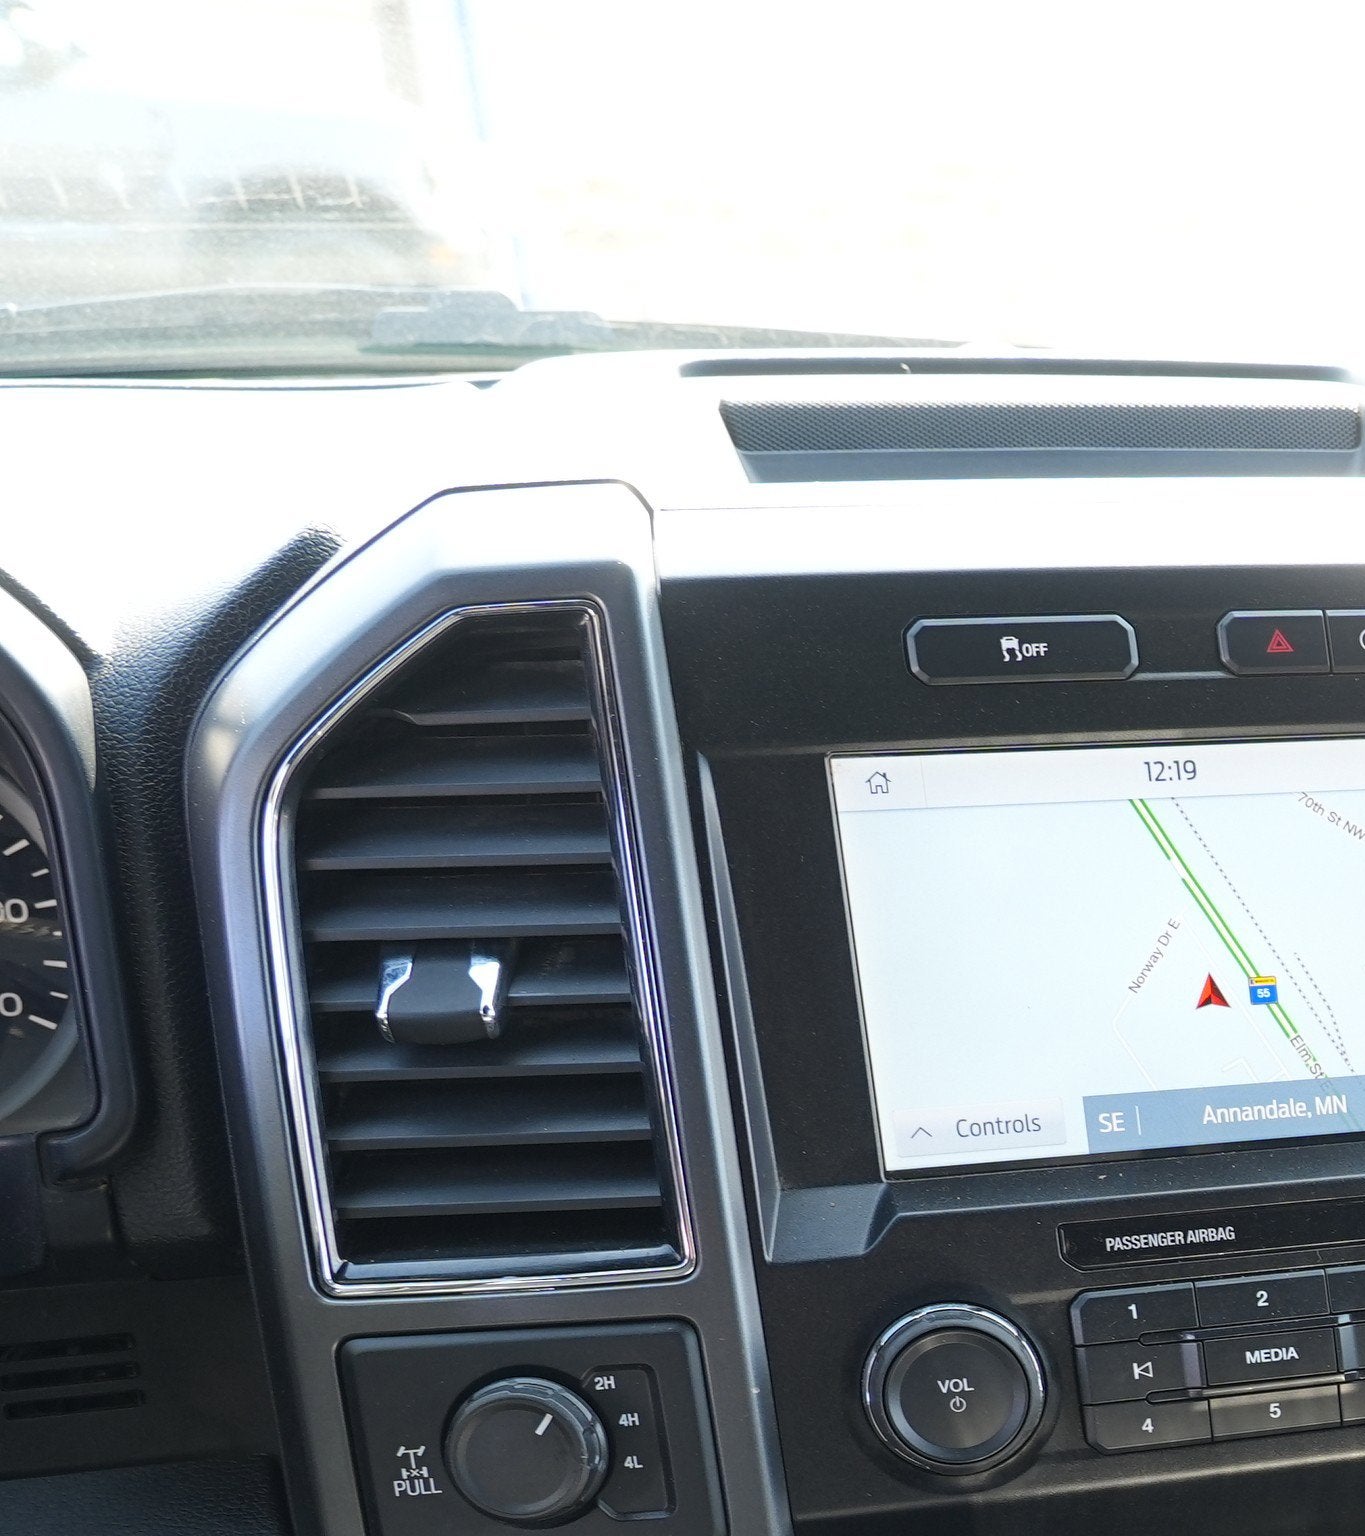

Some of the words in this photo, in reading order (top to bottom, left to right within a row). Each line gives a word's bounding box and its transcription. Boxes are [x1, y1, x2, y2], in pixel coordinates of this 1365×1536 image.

[1022, 642, 1049, 657] OFF
[1143, 758, 1198, 783] 12:19
[1297, 791, 1326, 816] 70th
[1327, 811, 1342, 826] St
[0, 898, 29, 924] 0
[1127, 946, 1165, 994] Norway
[1157, 930, 1173, 948] Dr
[1168, 917, 1181, 931] E
[1256, 987, 1271, 999] 55
[1290, 1034, 1312, 1063] Elm
[1309, 1062, 1326, 1079] St
[1098, 1111, 1125, 1133] SE
[1202, 1096, 1312, 1125] Annandale,
[1315, 1094, 1348, 1116] MN
[956, 1113, 1042, 1138] Controls
[1105, 1230, 1185, 1252] PASSENGER
[1186, 1226, 1236, 1244] AIRBAG
[1256, 1290, 1270, 1307] 2
[1127, 1304, 1139, 1320] 1
[1245, 1346, 1300, 1365] MEDIA
[594, 1375, 616, 1391] 2H
[936, 1377, 975, 1394] VOL
[618, 1412, 640, 1428] 4H
[1269, 1403, 1282, 1419] 5
[1141, 1417, 1154, 1434] 4
[623, 1455, 644, 1470] 4L
[393, 1477, 443, 1497] PULL
